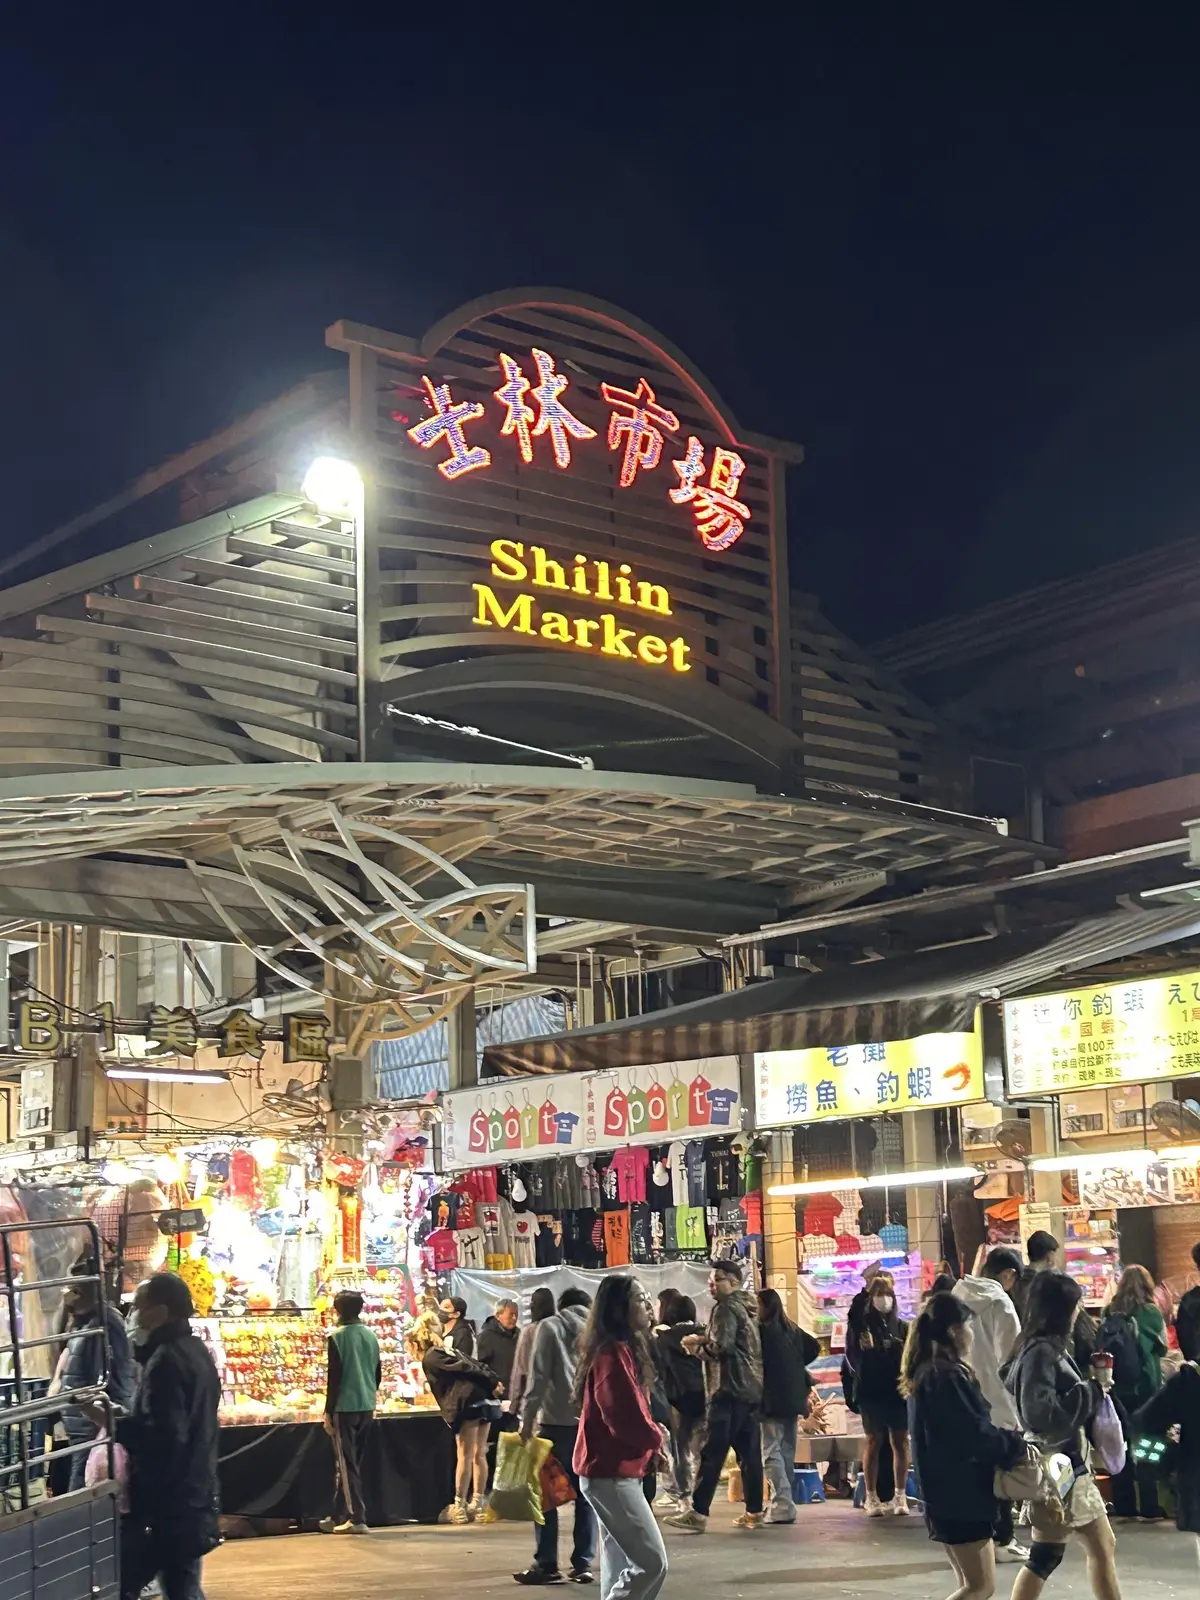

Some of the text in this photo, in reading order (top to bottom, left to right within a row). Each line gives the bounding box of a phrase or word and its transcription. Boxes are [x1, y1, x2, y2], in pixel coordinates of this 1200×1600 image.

[408, 348, 751, 552] 士林市場
[490, 538, 673, 616] Shilin
[471, 582, 692, 672] Market
[607, 1087, 705, 1134] Sport
[786, 1067, 932, 1114] 撈魚、釣蝦
[471, 1110, 553, 1150] Sport
